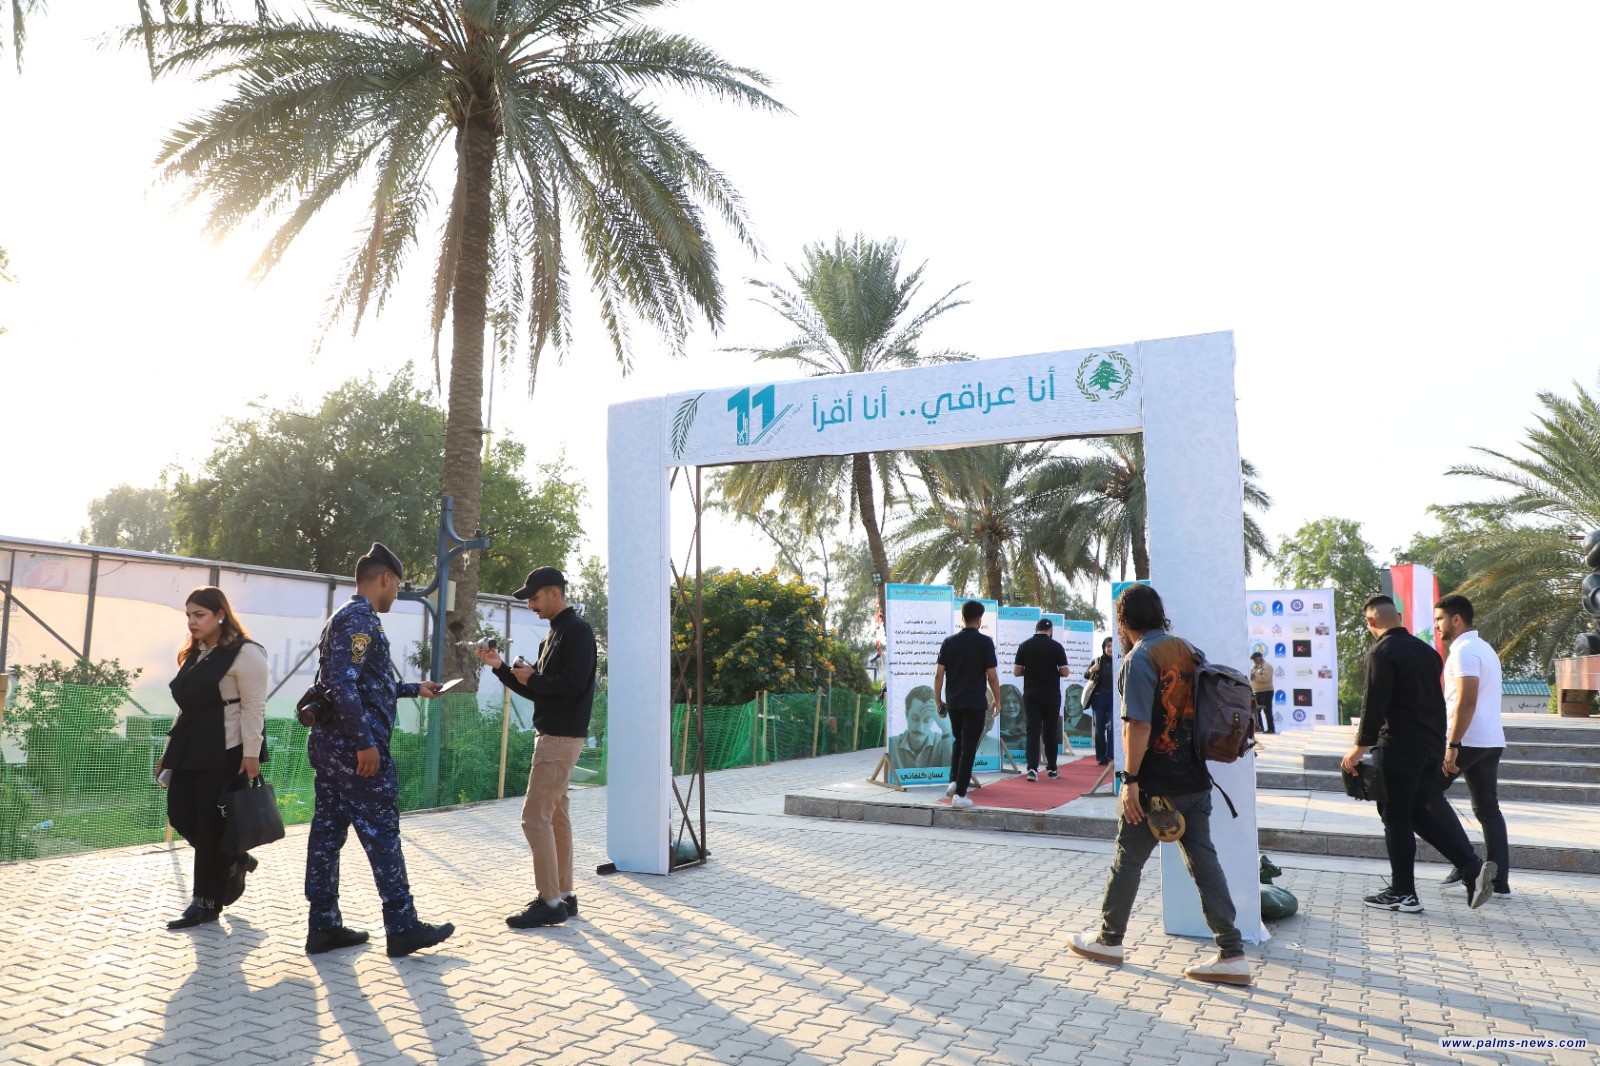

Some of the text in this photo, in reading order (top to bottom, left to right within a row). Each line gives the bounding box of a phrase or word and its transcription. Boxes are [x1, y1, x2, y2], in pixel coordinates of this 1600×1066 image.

[1027, 365, 1056, 402] أنا
[812, 389, 854, 433] أقرأ
[863, 385, 888, 420] أنا
[900, 771, 944, 781] غسان كنفاني
